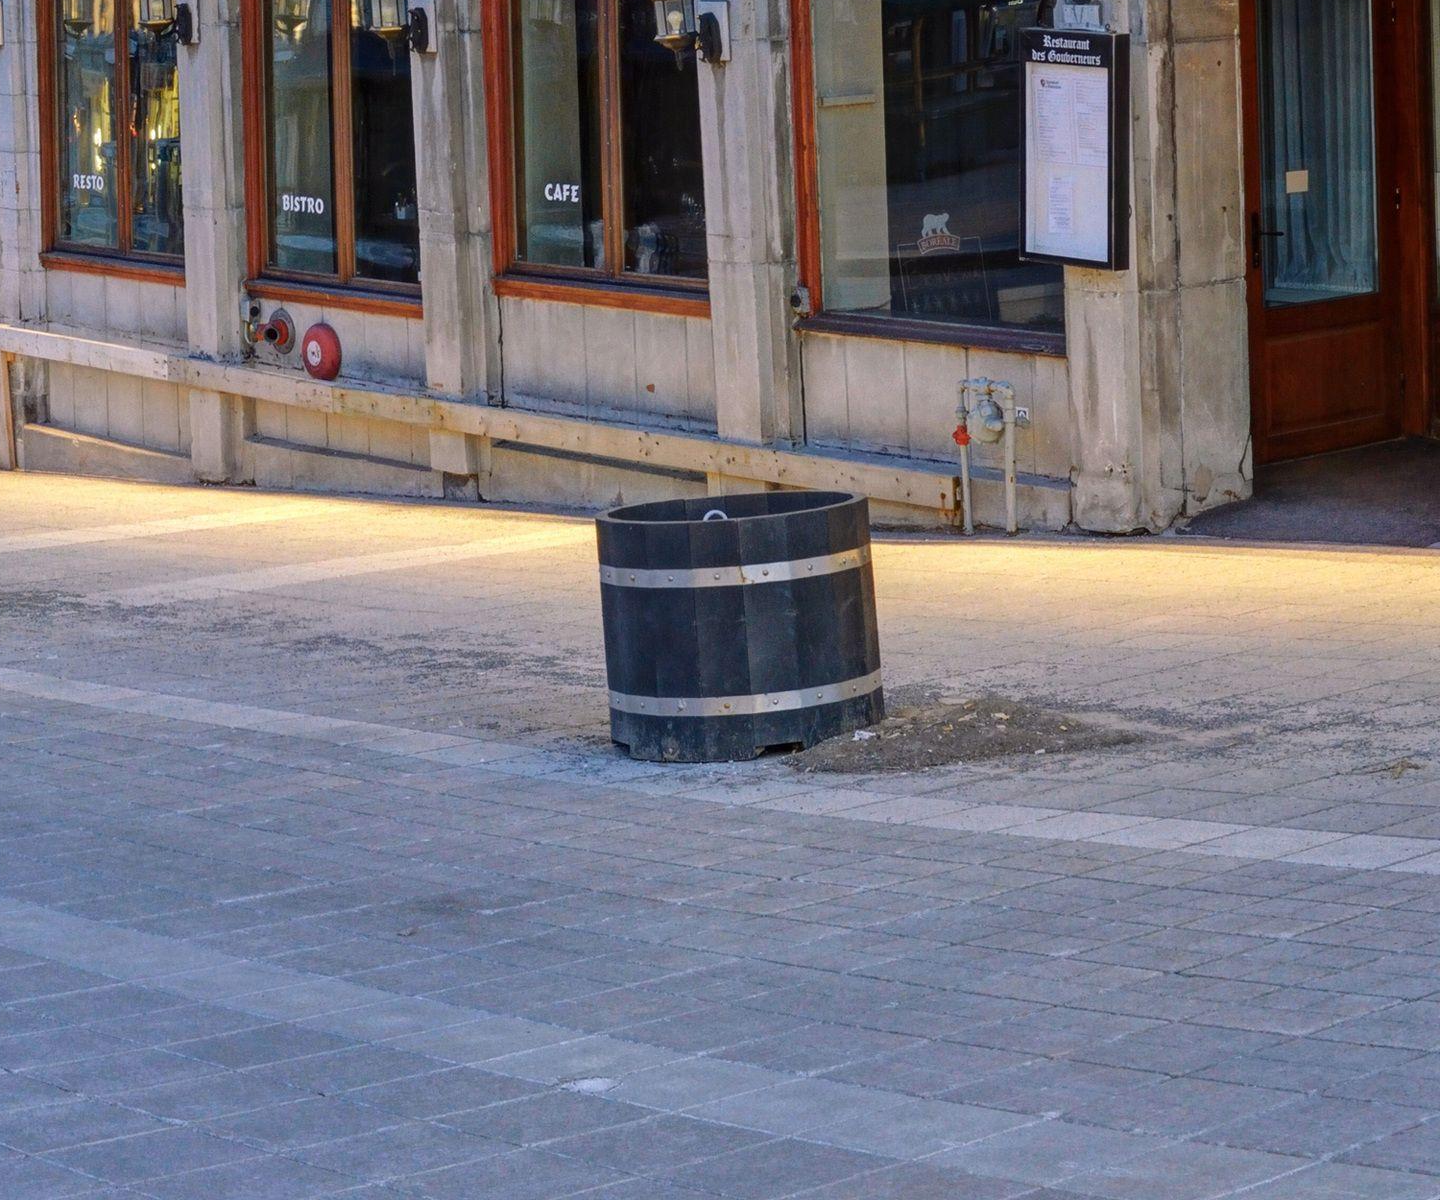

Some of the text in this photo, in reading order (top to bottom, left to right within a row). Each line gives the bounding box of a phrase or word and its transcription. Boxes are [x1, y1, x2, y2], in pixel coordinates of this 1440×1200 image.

[1043, 34, 1090, 50] Restaurant
[1031, 49, 1101, 66] des Gouverneurs
[73, 174, 104, 190] RESTO
[544, 183, 580, 202] CAFE
[282, 195, 324, 215] BISTRO
